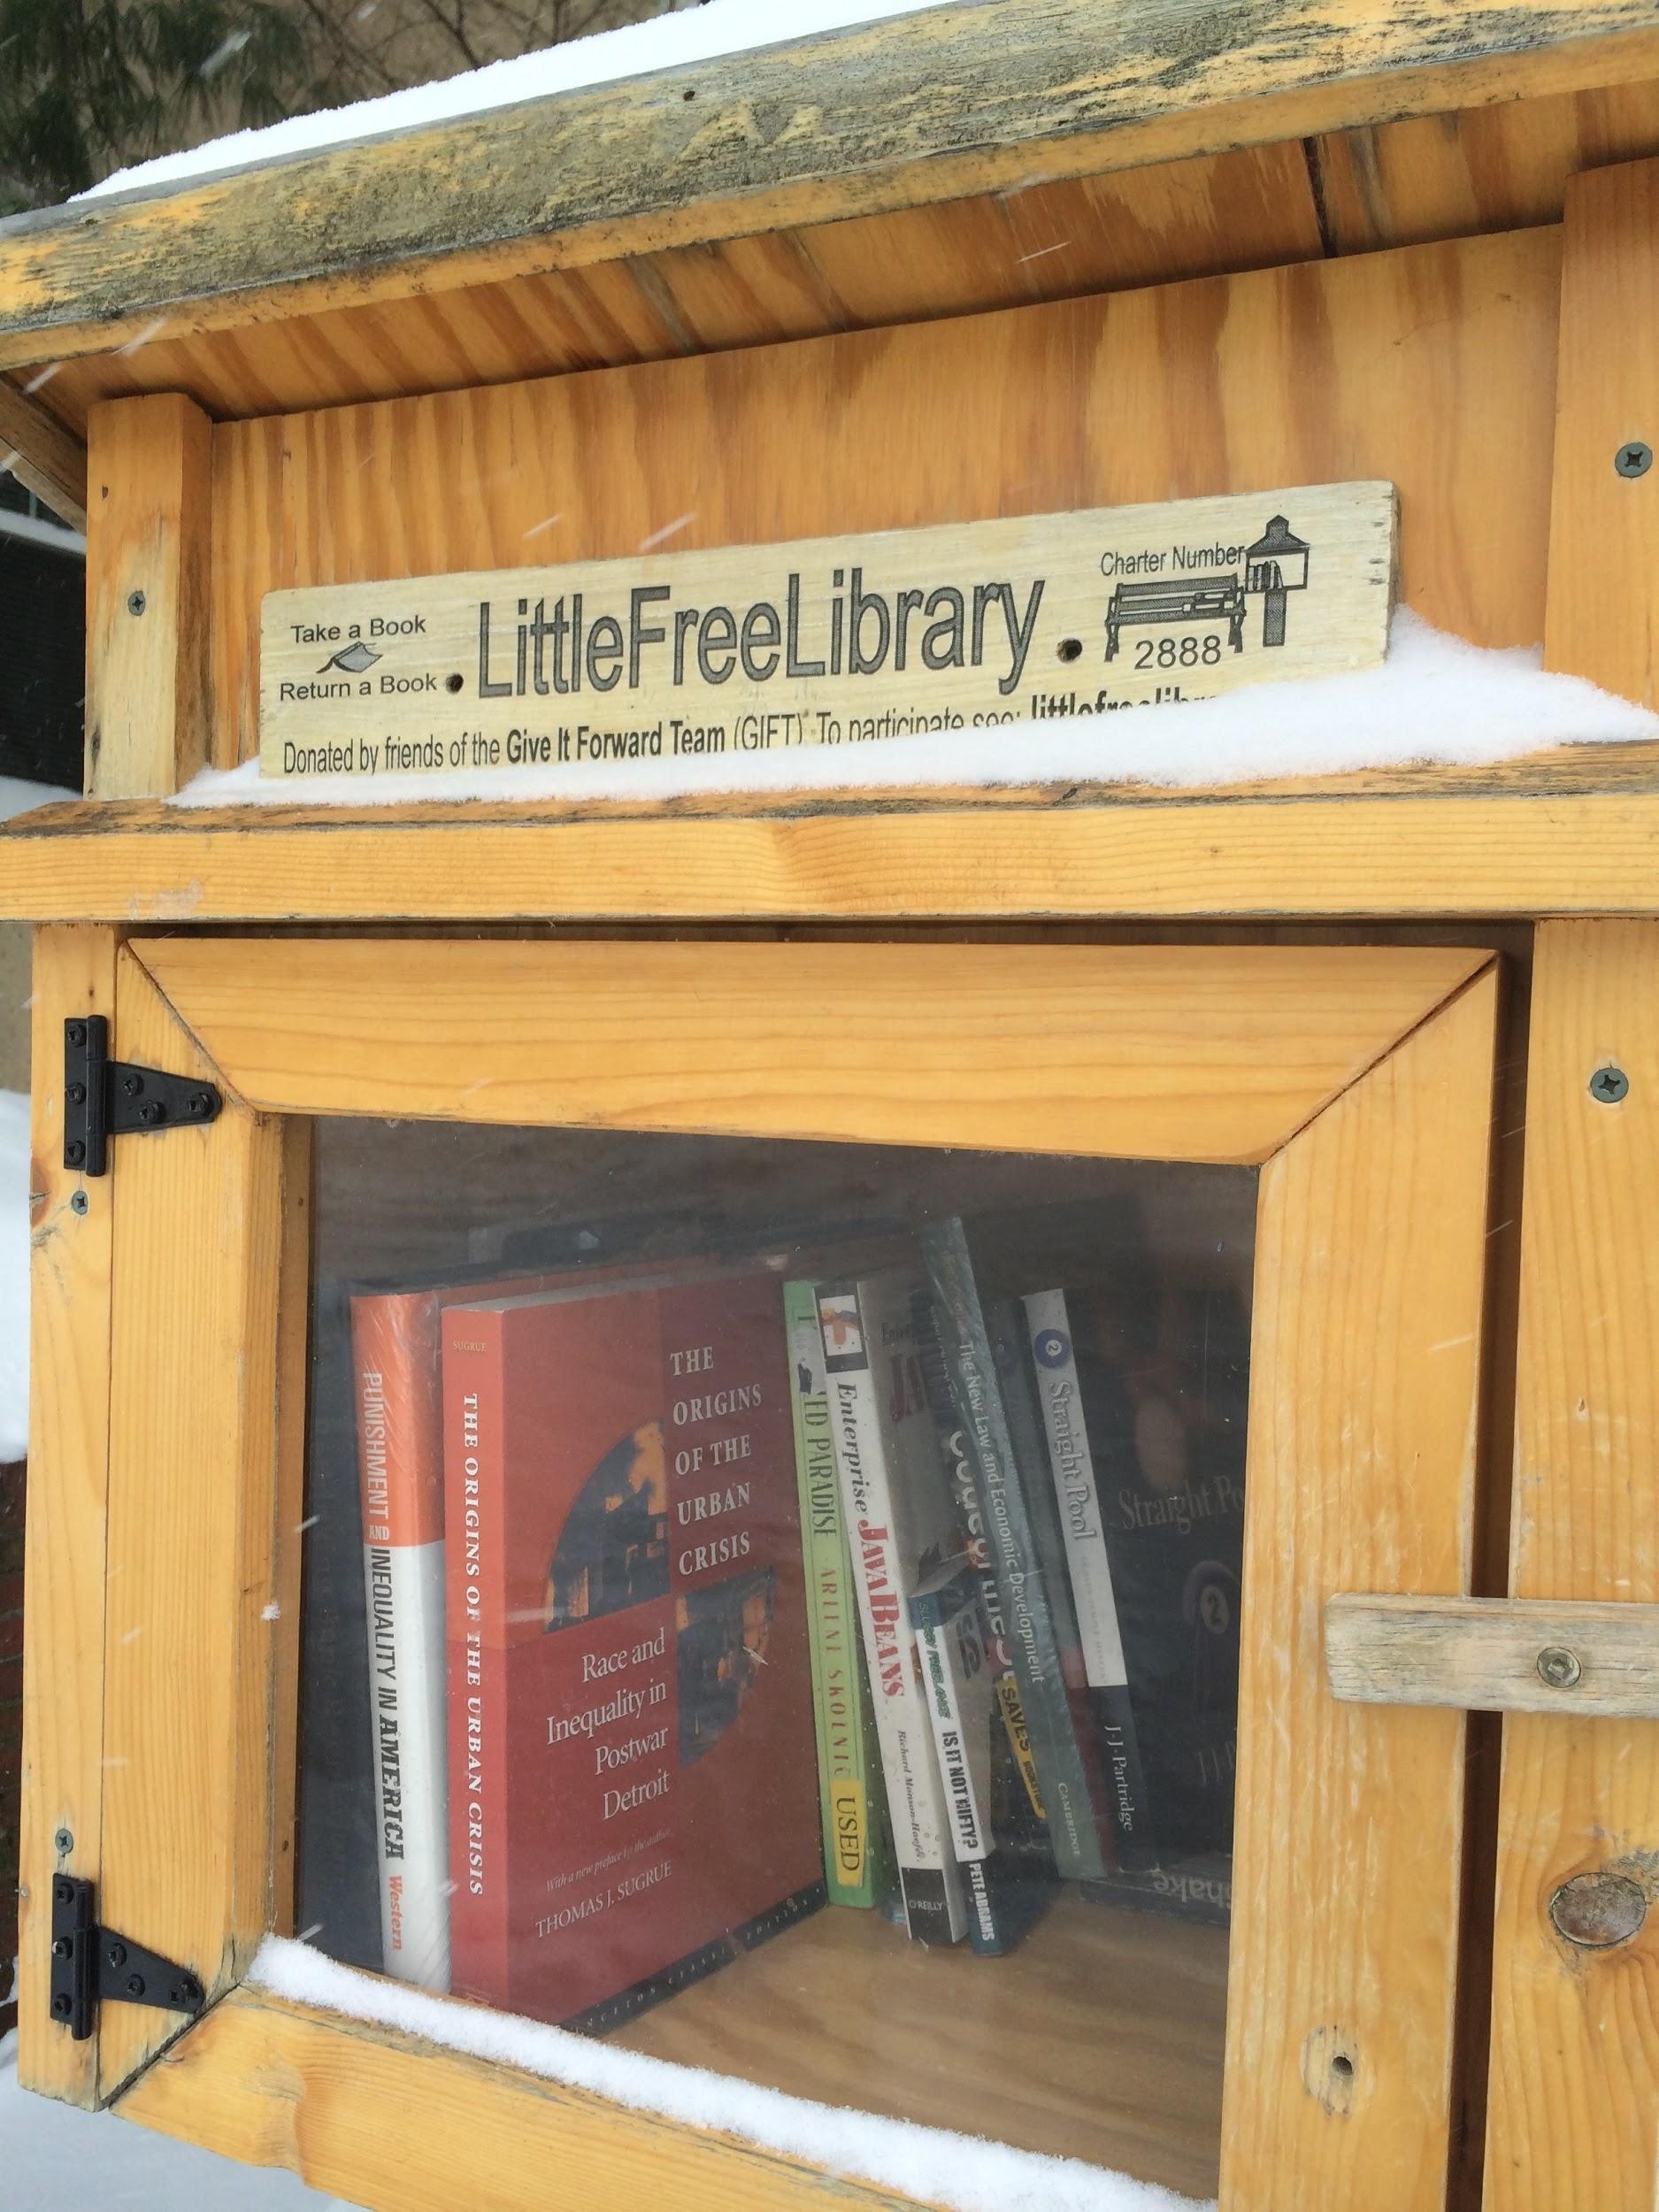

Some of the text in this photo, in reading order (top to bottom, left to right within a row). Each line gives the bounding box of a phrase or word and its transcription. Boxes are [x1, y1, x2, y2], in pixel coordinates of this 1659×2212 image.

[1101, 541, 1245, 576] Charter Number
[290, 615, 426, 643] Take a Book
[478, 567, 1046, 695] LittleFreeLibrary
[1134, 635, 1221, 670] 2888
[280, 672, 438, 701] Return a Book
[284, 739, 353, 774] Donated
[360, 738, 379, 775] by
[385, 734, 443, 770] friends
[449, 732, 468, 766] of
[472, 732, 500, 765] the
[507, 728, 551, 764] Give
[558, 726, 570, 762] It
[577, 721, 663, 760] Forward
[670, 720, 725, 756] Team
[733, 713, 803, 750] (GIFT)
[816, 711, 841, 745] To
[670, 1346, 714, 1376] THE
[673, 1383, 762, 1426] ORIGINS
[674, 1434, 751, 1476] OF THE
[836, 1380, 870, 1515] Enterprise
[1048, 1380, 1083, 1480] Straight
[1066, 1484, 1097, 1540] Pool
[677, 1481, 751, 1526] URBAN
[806, 1437, 837, 1537] PARADISE
[959, 1341, 1045, 1684] The New Law and Economic Development
[1118, 1479, 1210, 1534] Straight
[679, 1531, 750, 1576] CRISIS
[362, 1372, 404, 1860] PUNISHMENT AND INEQUALITY IN AMERICA
[464, 1394, 483, 1896] THE ORIGINS OF THE URBAN CRISIS
[581, 1626, 665, 1683] Race and
[547, 1678, 667, 1745] Inequality in
[942, 1731, 958, 1748] IS
[1002, 1687, 1031, 1752] SAVES
[595, 1727, 669, 1776] Postwar
[945, 1749, 963, 1765] IT
[603, 1768, 671, 1821] Detroit
[949, 1766, 968, 1795] NOT
[1112, 1756, 1135, 1832] Partridge
[836, 1796, 859, 1872] USED
[535, 1893, 603, 1939] THOMAS
[618, 1860, 672, 1901] SUGRUE
[546, 1873, 568, 1892] With
[576, 1864, 594, 1881] new
[969, 1862, 995, 1941] PETE ABRAMS
[388, 1875, 403, 1951] Western
